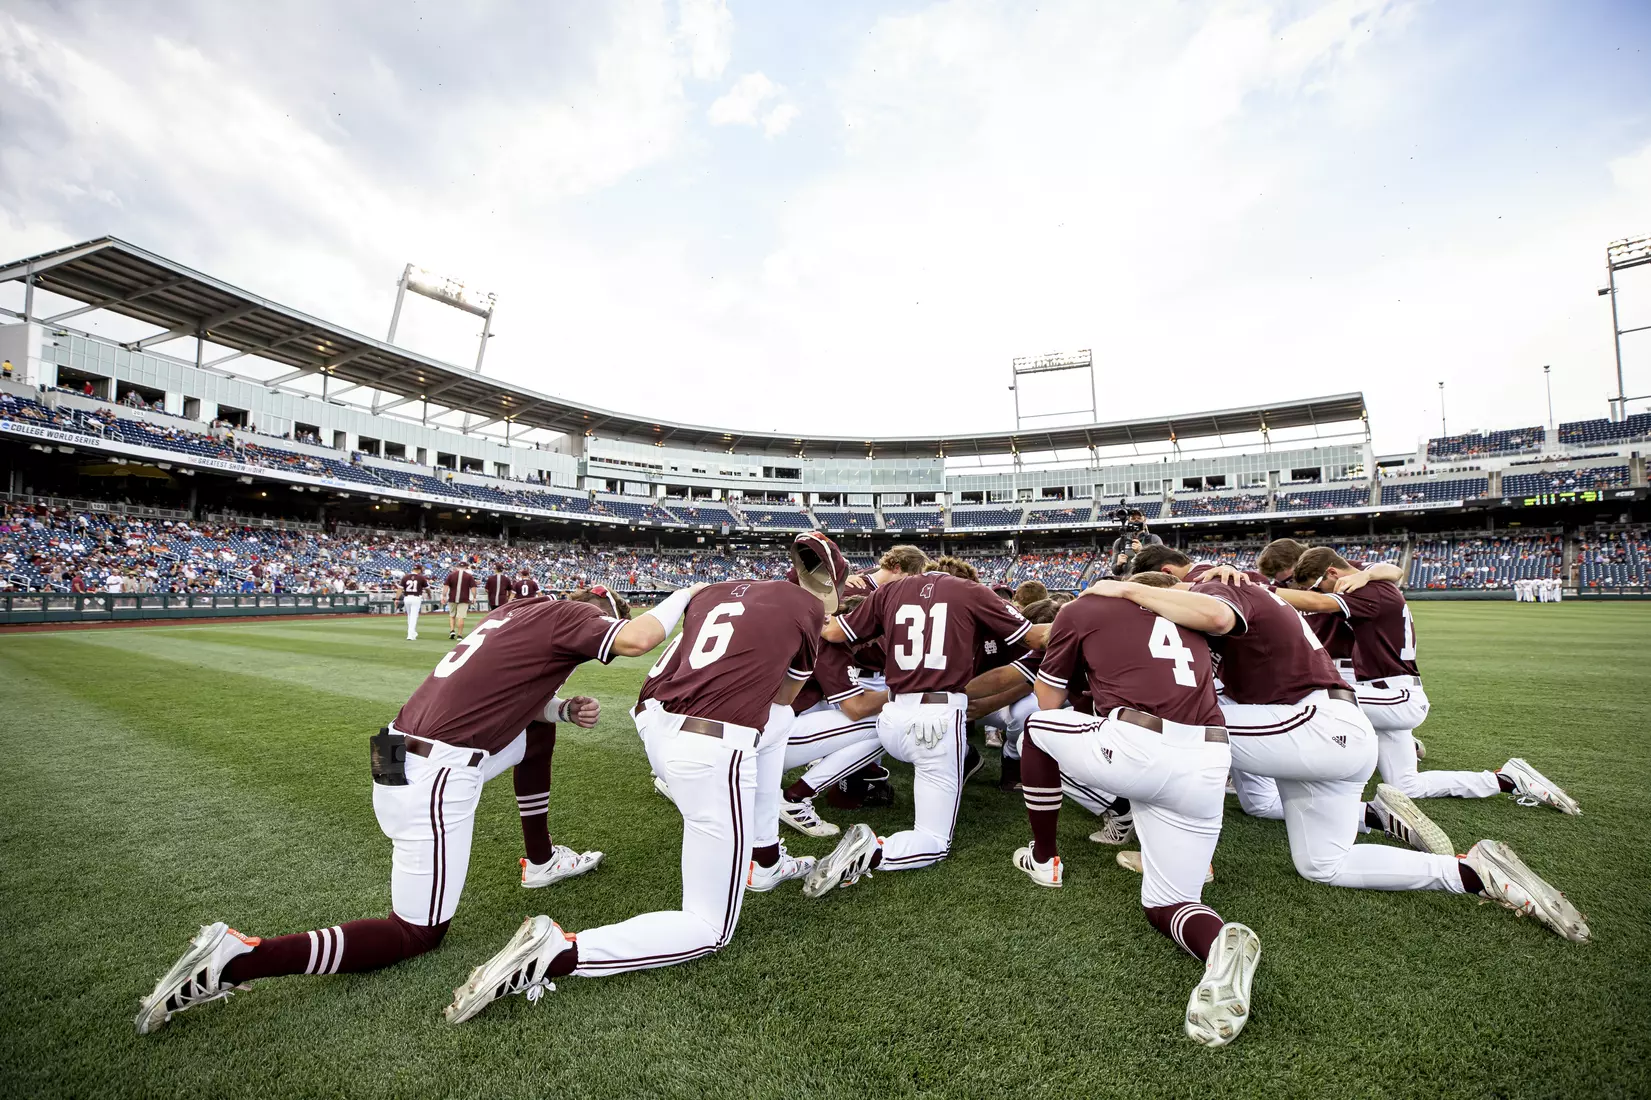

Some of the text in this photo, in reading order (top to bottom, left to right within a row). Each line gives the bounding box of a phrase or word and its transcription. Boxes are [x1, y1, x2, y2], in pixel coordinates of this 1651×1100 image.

[10, 423, 101, 446] COLLEGE WORLD SERIES
[198, 458, 228, 469] GREATEST
[229, 463, 246, 471] SHOW
[406, 580, 418, 593] 21
[521, 584, 529, 597] 0
[433, 616, 512, 679] 5
[688, 601, 746, 670] 6
[894, 602, 948, 671] 31
[1148, 616, 1198, 688] 4
